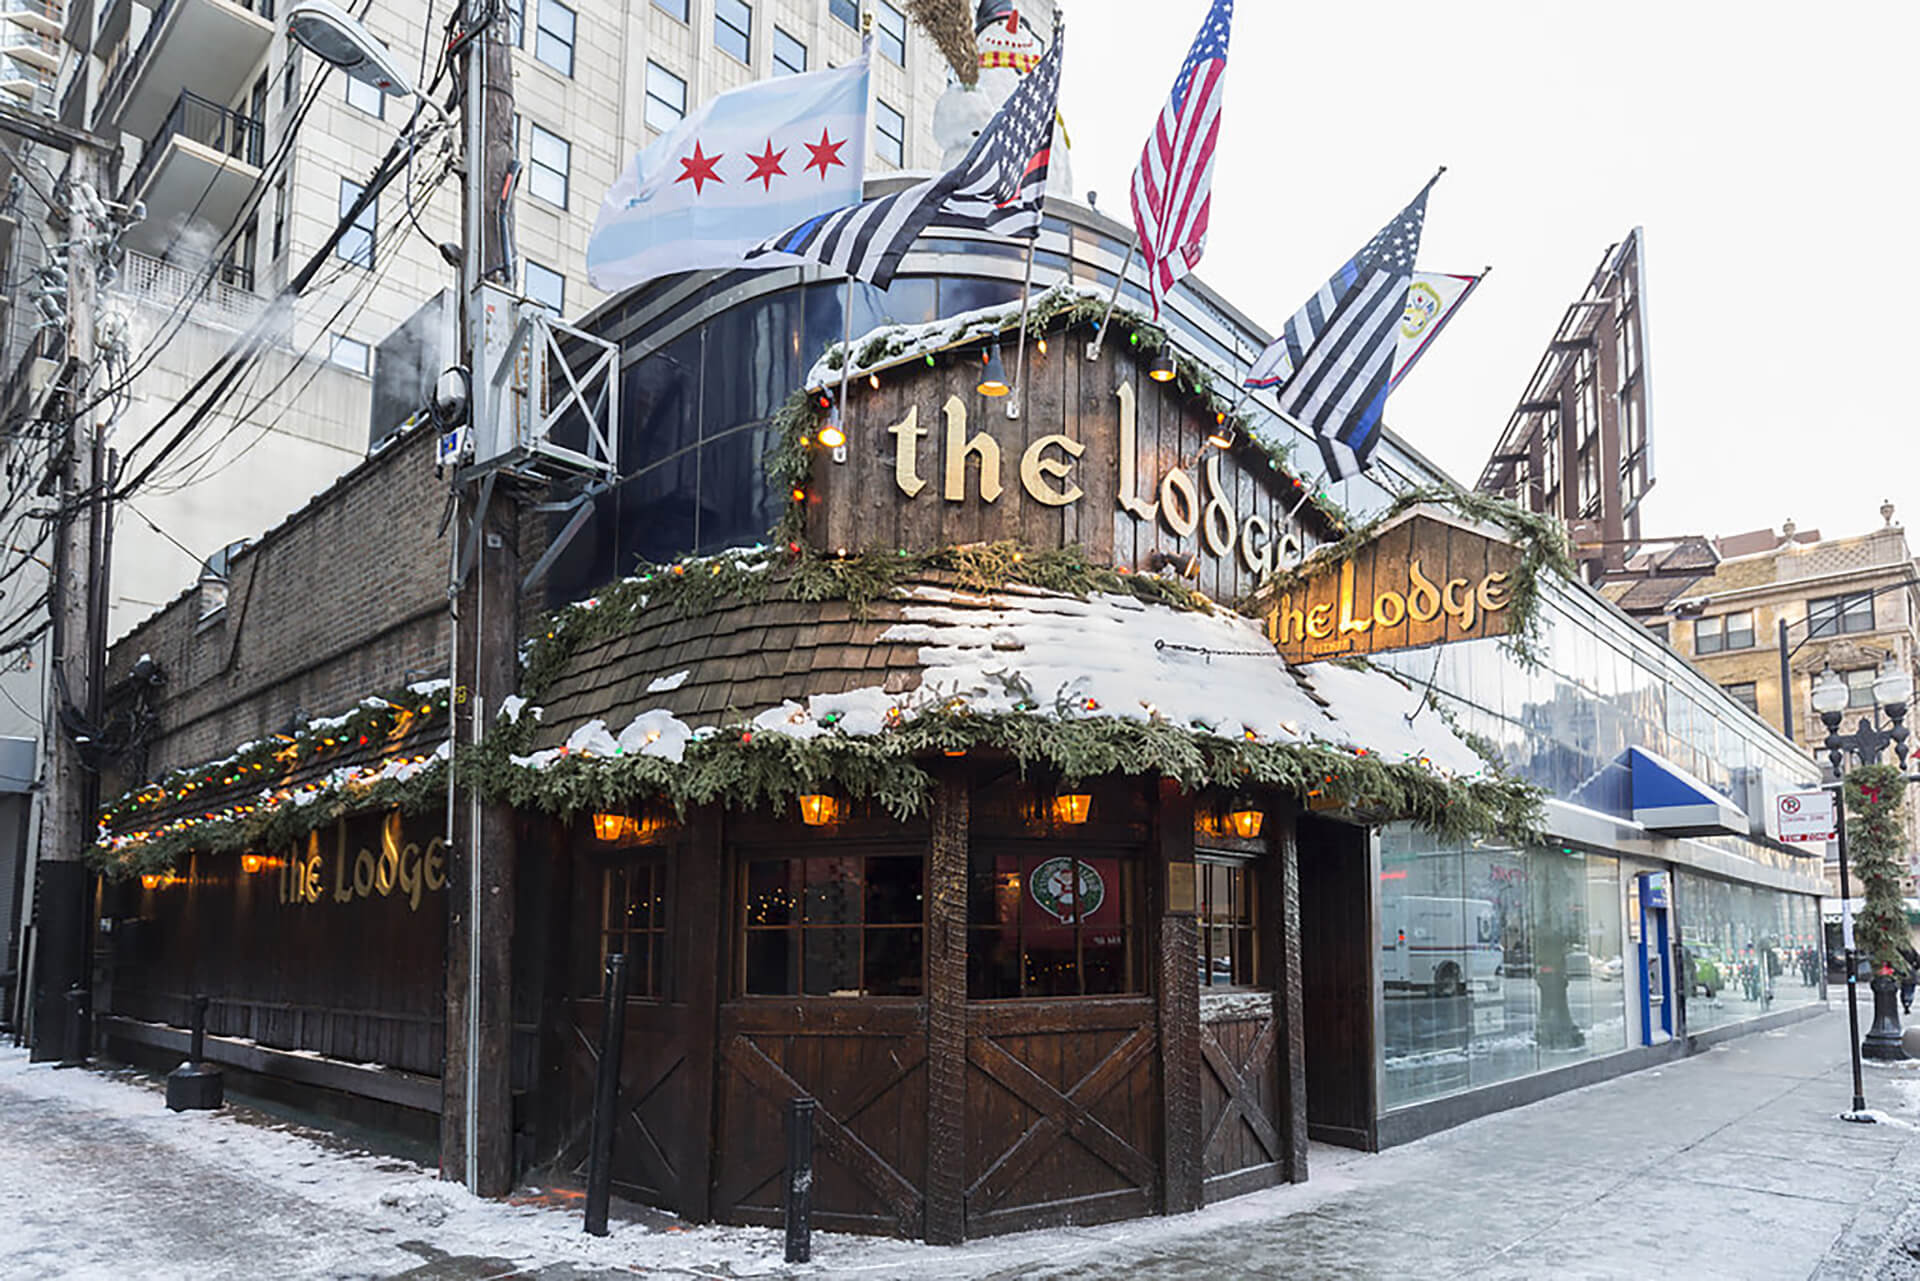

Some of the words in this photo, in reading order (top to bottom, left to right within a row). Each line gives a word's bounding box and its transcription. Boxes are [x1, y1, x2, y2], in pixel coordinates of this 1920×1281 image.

[888, 395, 1086, 506] the
[1266, 593, 1334, 646] the
[1338, 556, 1511, 634] Lodge
[334, 814, 446, 912] Lodge
